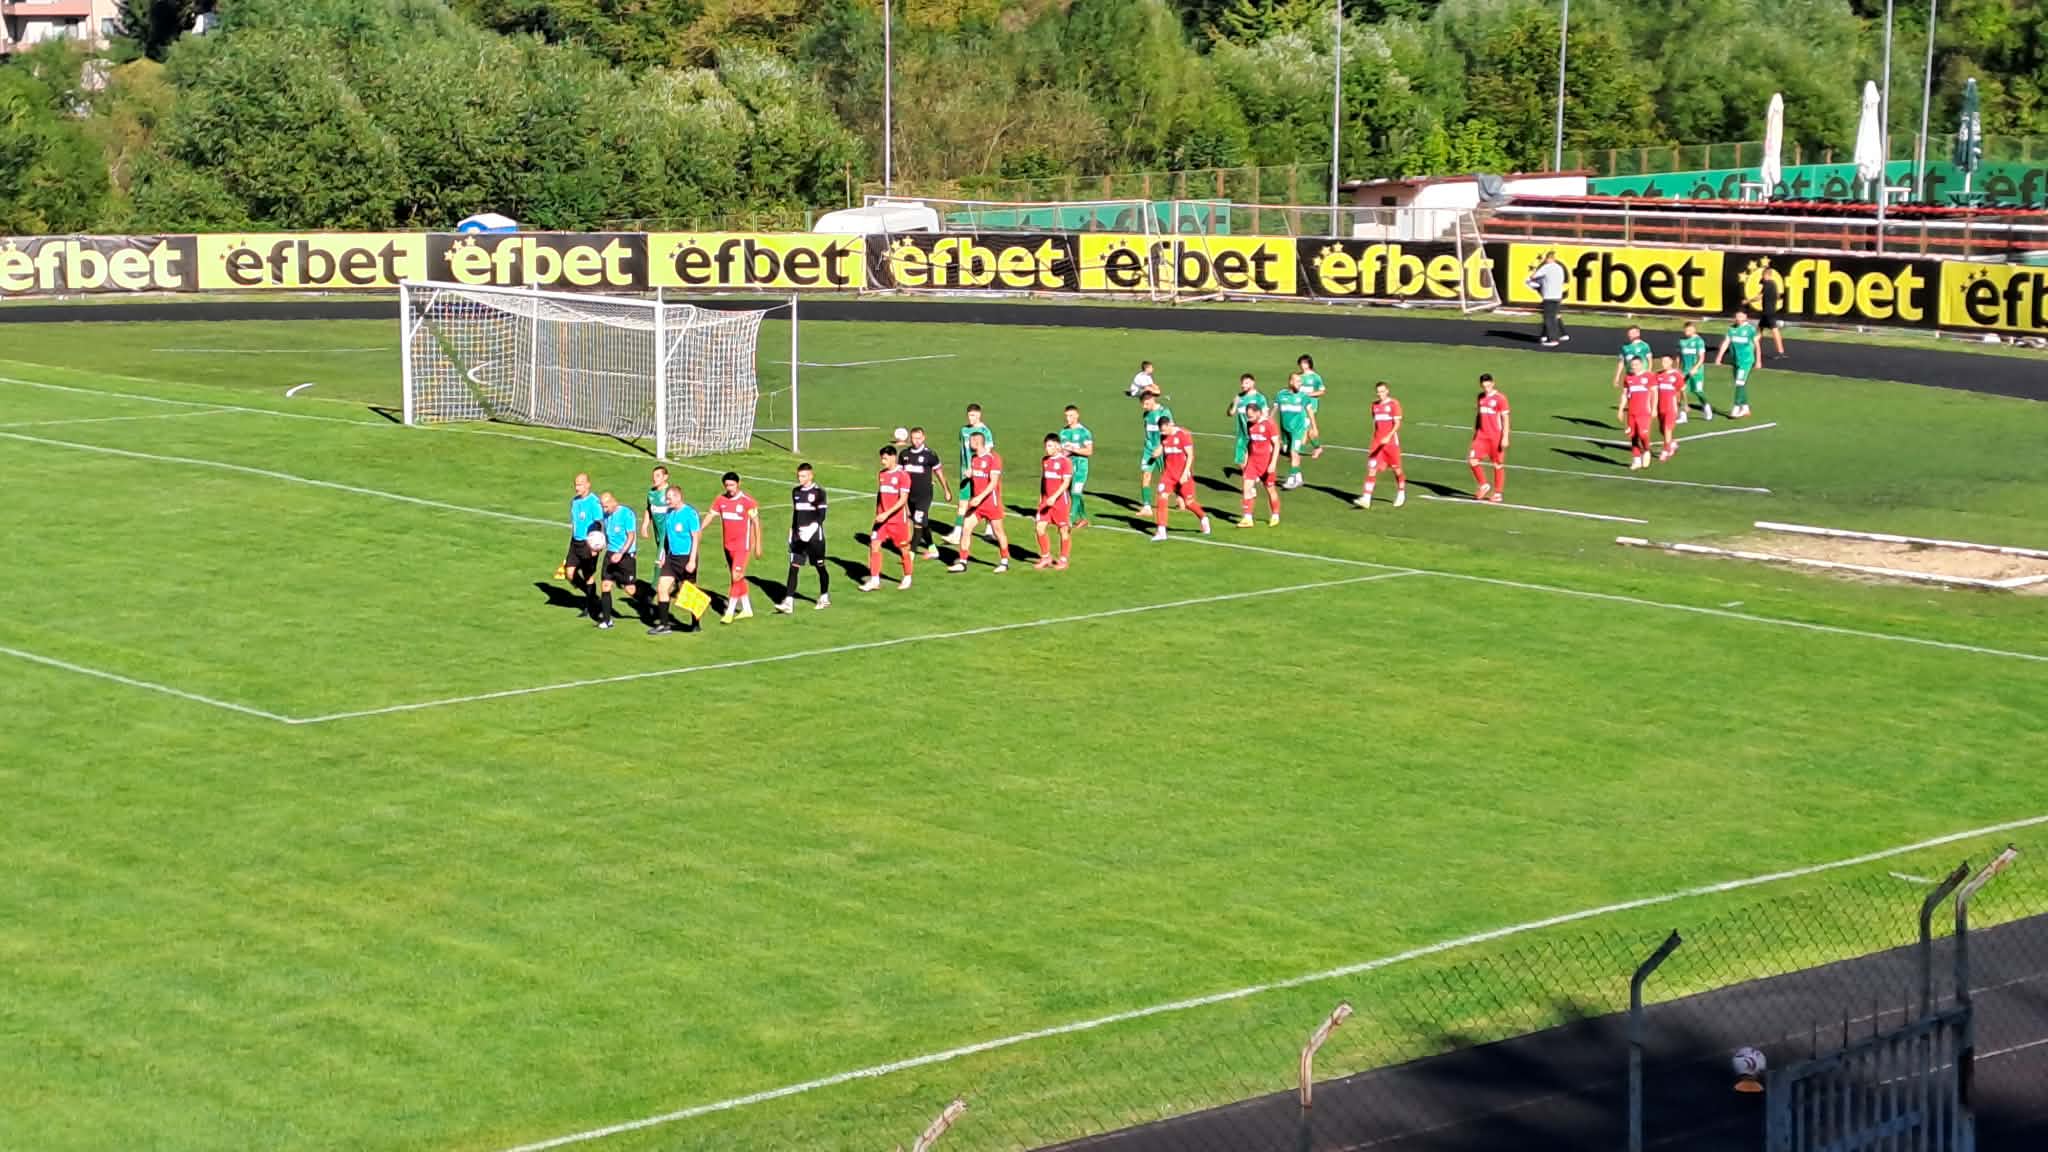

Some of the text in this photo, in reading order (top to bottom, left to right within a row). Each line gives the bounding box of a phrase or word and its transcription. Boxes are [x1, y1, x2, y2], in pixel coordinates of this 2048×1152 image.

[0, 239, 182, 291] efbet
[225, 239, 407, 285] efbet
[450, 237, 634, 285] efbet
[674, 238, 849, 285] efbet
[891, 238, 1066, 288] efbet
[1105, 240, 1278, 290] efbet
[1319, 244, 1494, 298] efbet
